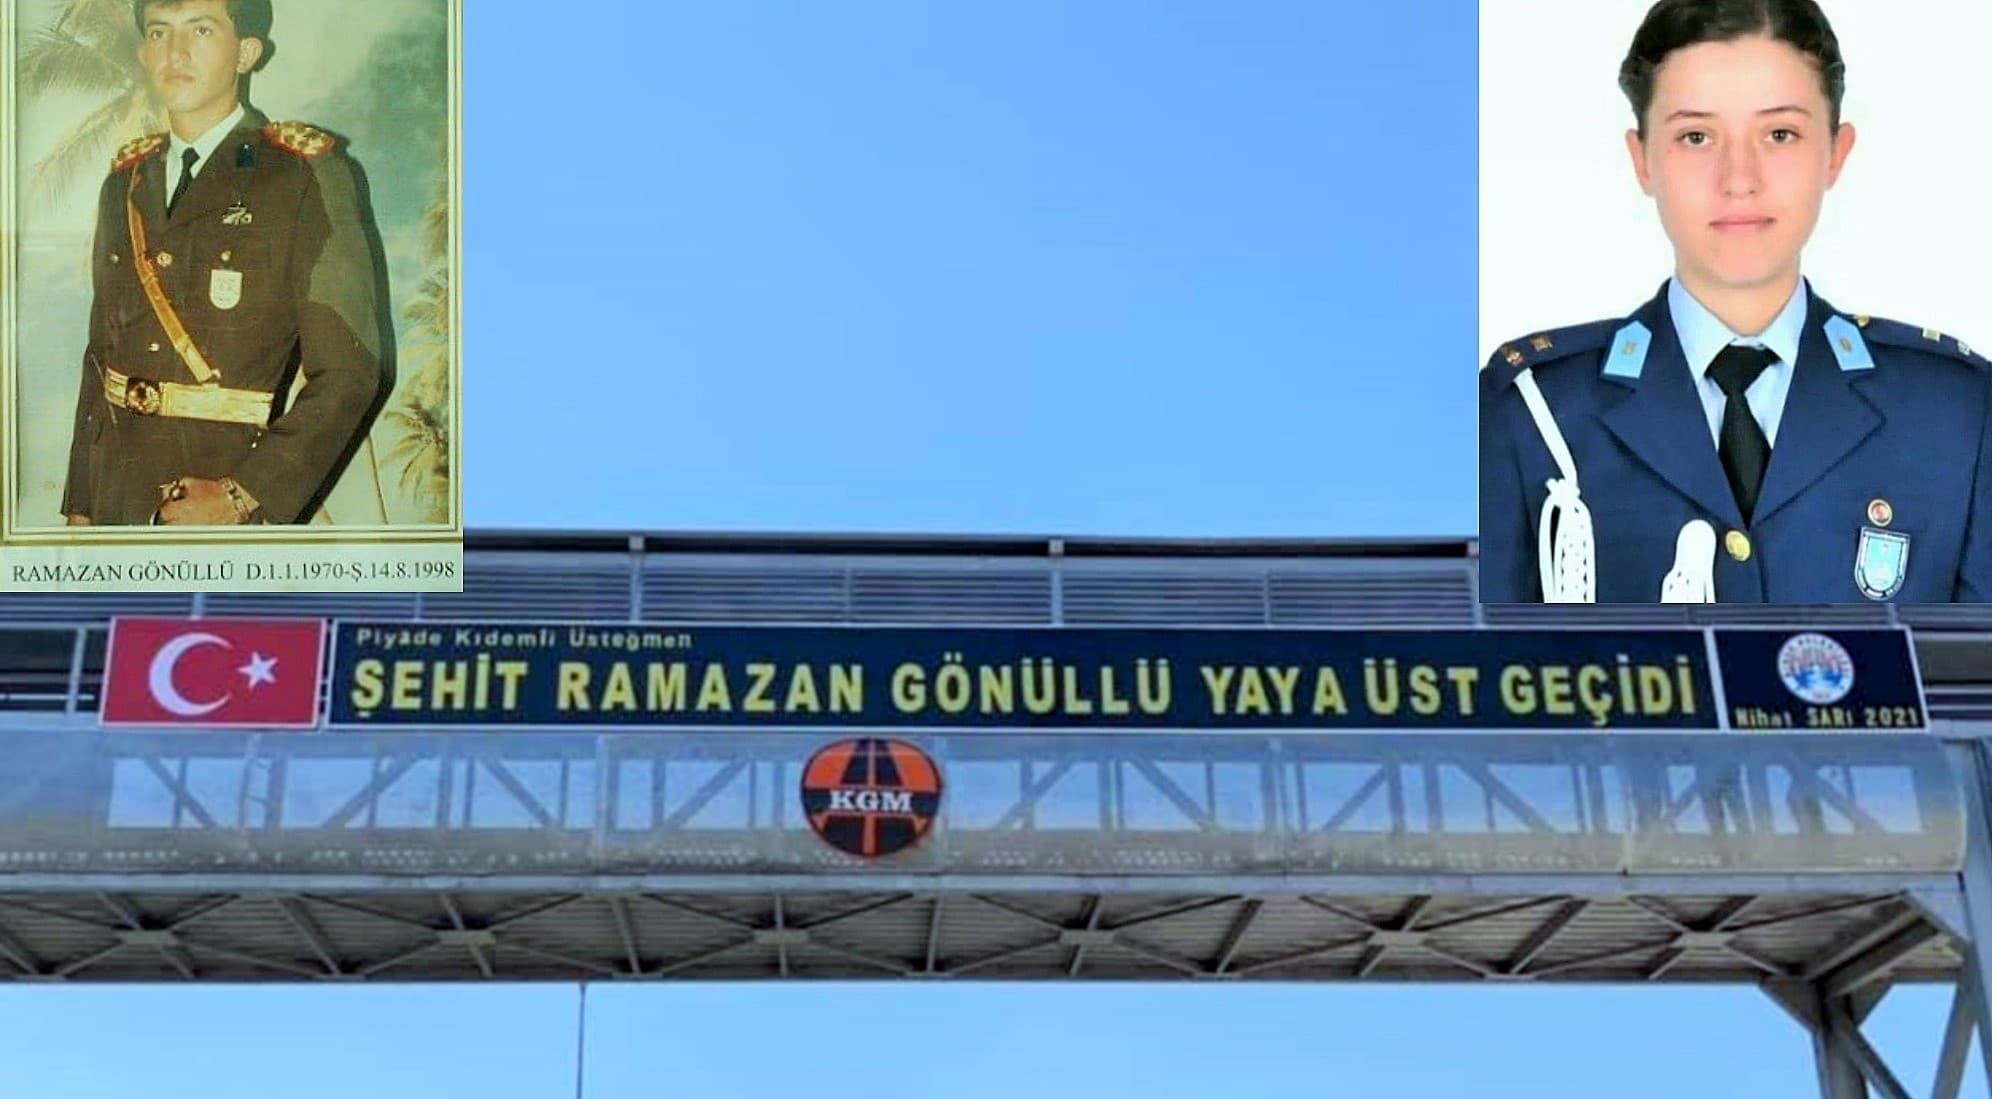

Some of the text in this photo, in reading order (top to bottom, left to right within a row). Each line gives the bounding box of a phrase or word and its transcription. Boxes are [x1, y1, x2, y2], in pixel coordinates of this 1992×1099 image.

[352, 652, 1696, 726] ŞEHİT RAMAZAN GÖNÜLLÜ YAYA ÜST GEÇİDİ
[1864, 706, 1918, 726] 2021
[829, 789, 914, 813] KGM
